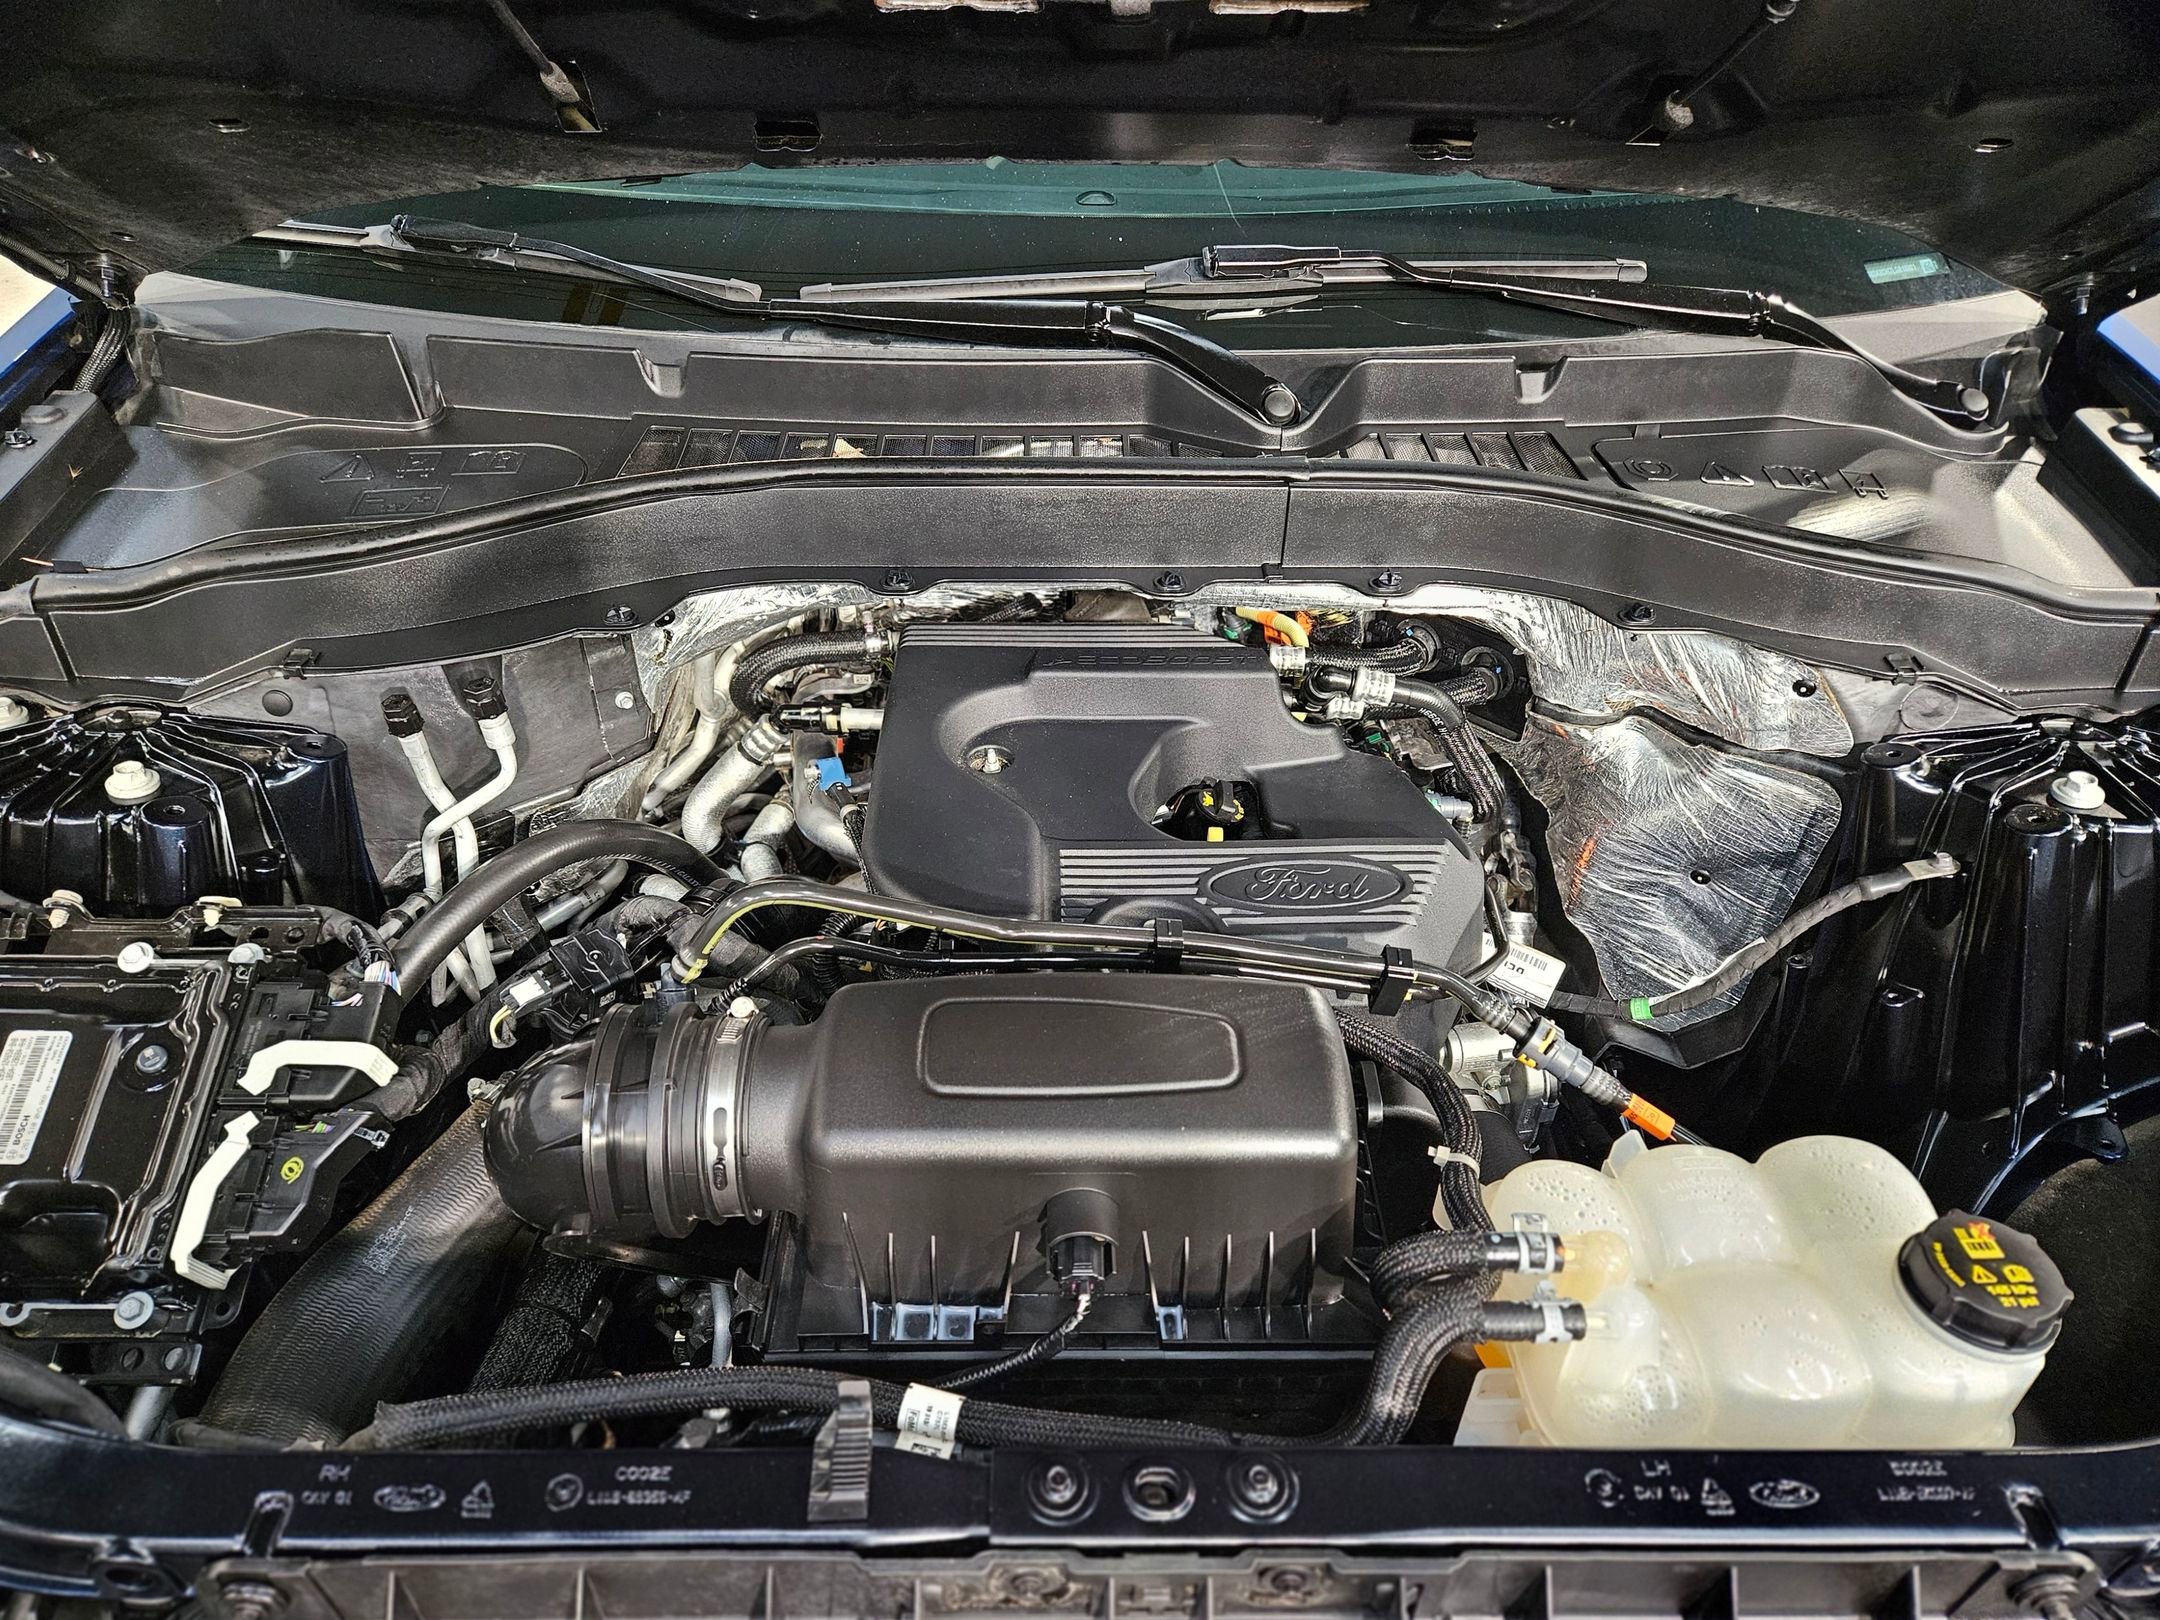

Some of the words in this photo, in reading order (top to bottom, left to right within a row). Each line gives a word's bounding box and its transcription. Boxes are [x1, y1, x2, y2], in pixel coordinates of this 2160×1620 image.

[1246, 866, 1370, 901] Ford
[12, 1115, 31, 1146] BOSCH
[318, 1464, 351, 1482] RH
[1641, 1459, 1671, 1477] LH
